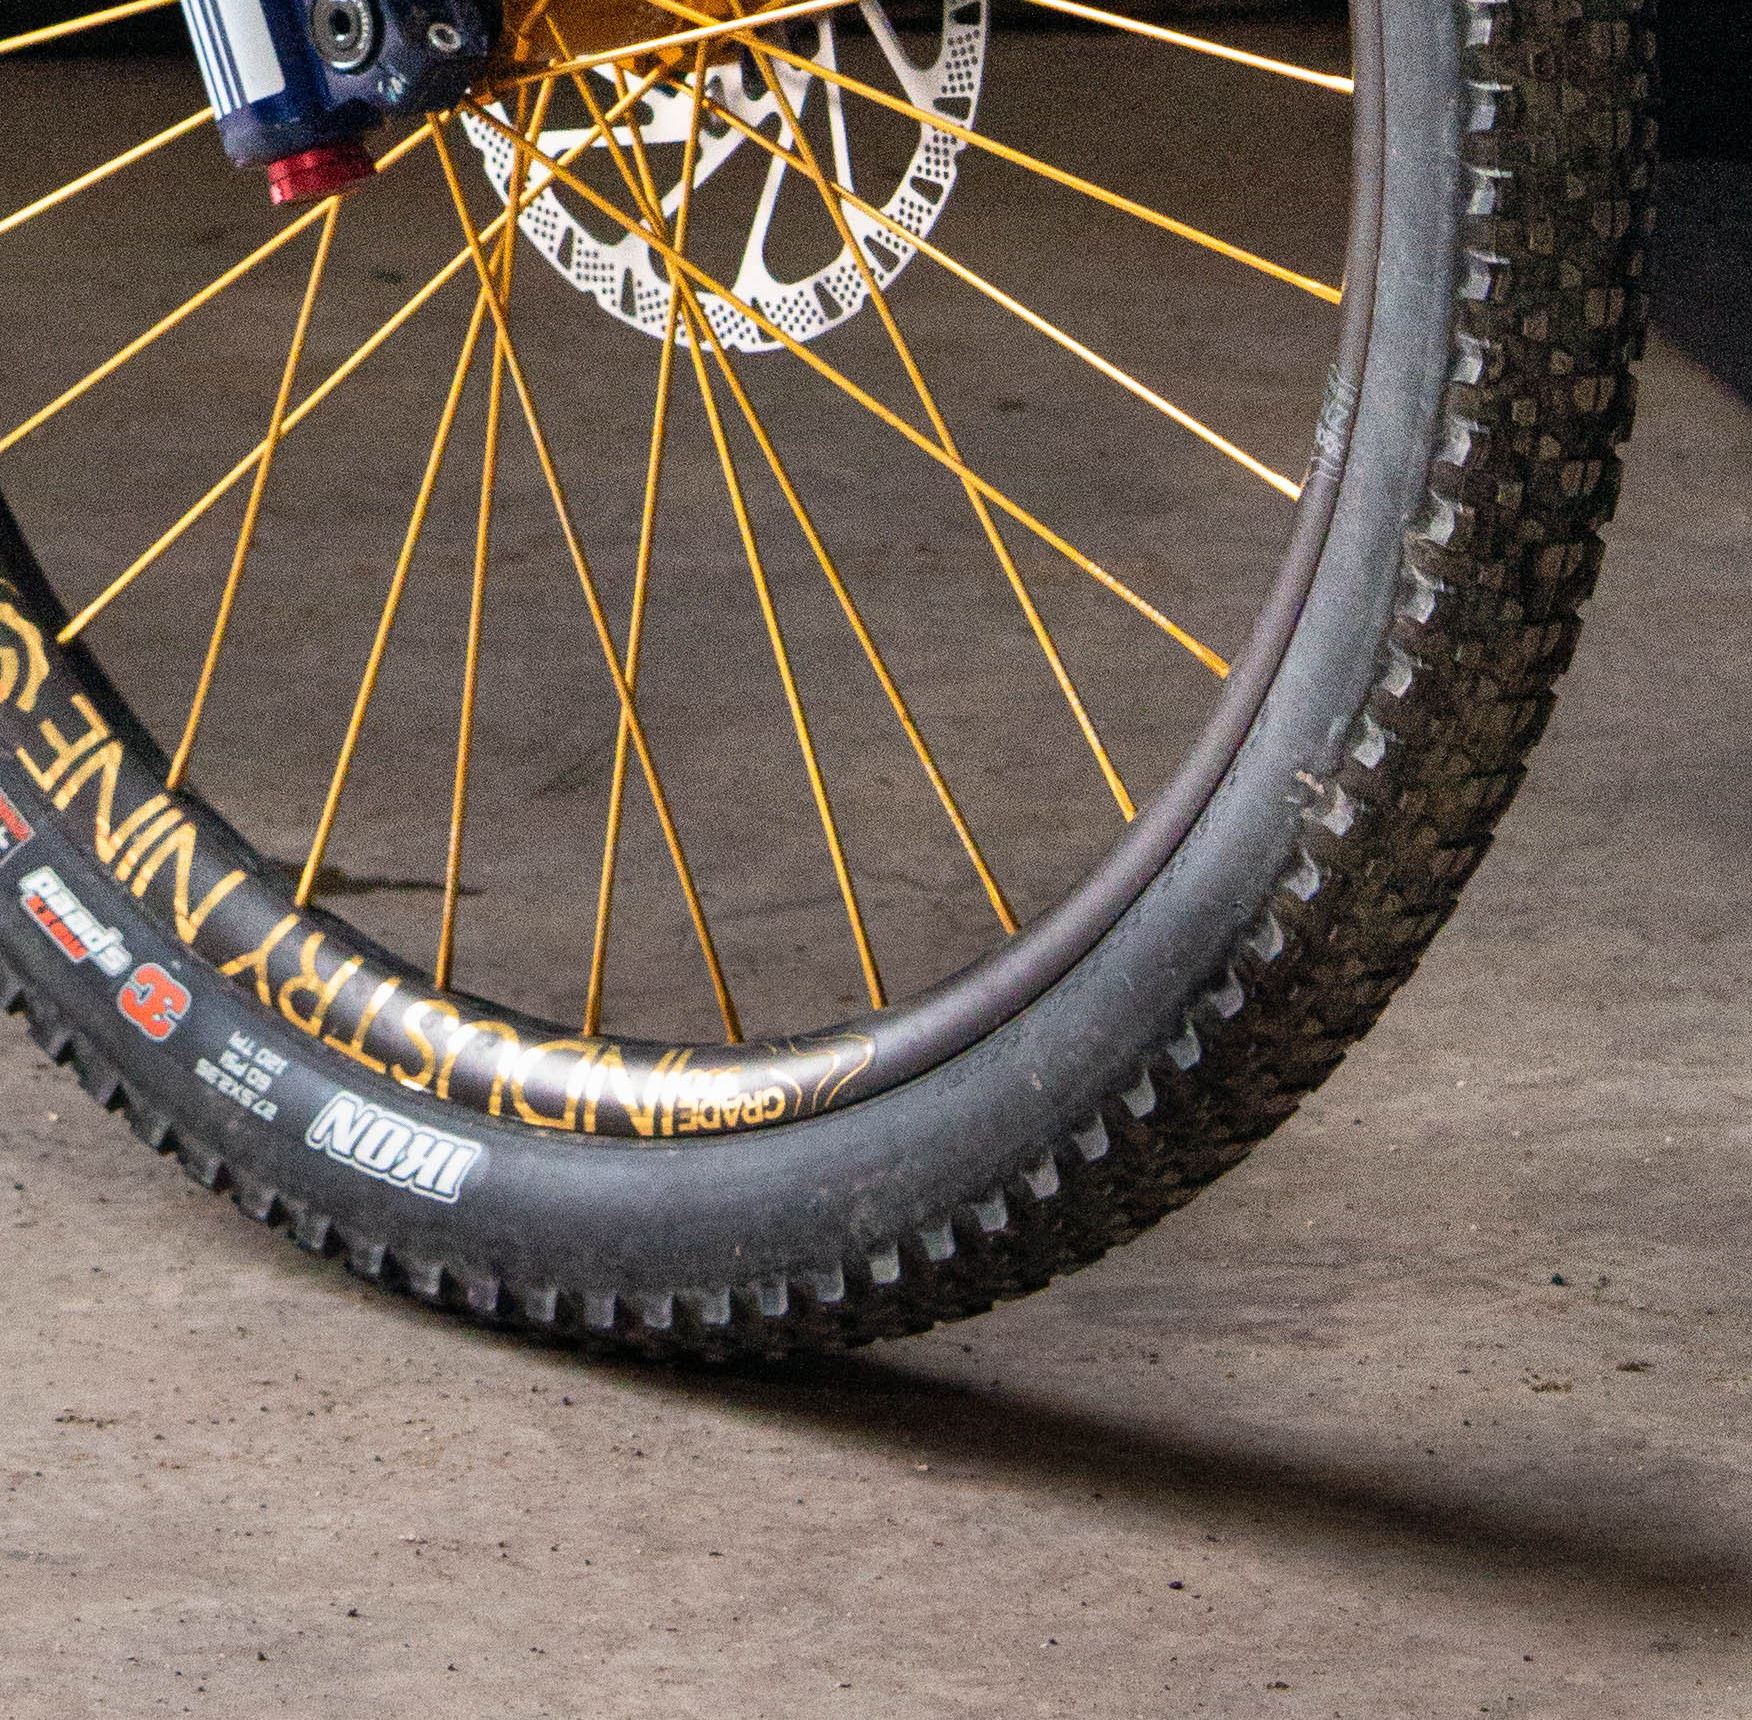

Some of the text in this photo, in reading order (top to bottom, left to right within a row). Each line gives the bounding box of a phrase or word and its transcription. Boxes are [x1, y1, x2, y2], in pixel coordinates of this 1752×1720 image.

[14, 692, 248, 944] NINE
[16, 865, 134, 978] speed
[223, 911, 693, 1139] INDUSTRY
[305, 1091, 481, 1204] IKON
[674, 1084, 787, 1132] GRADE
